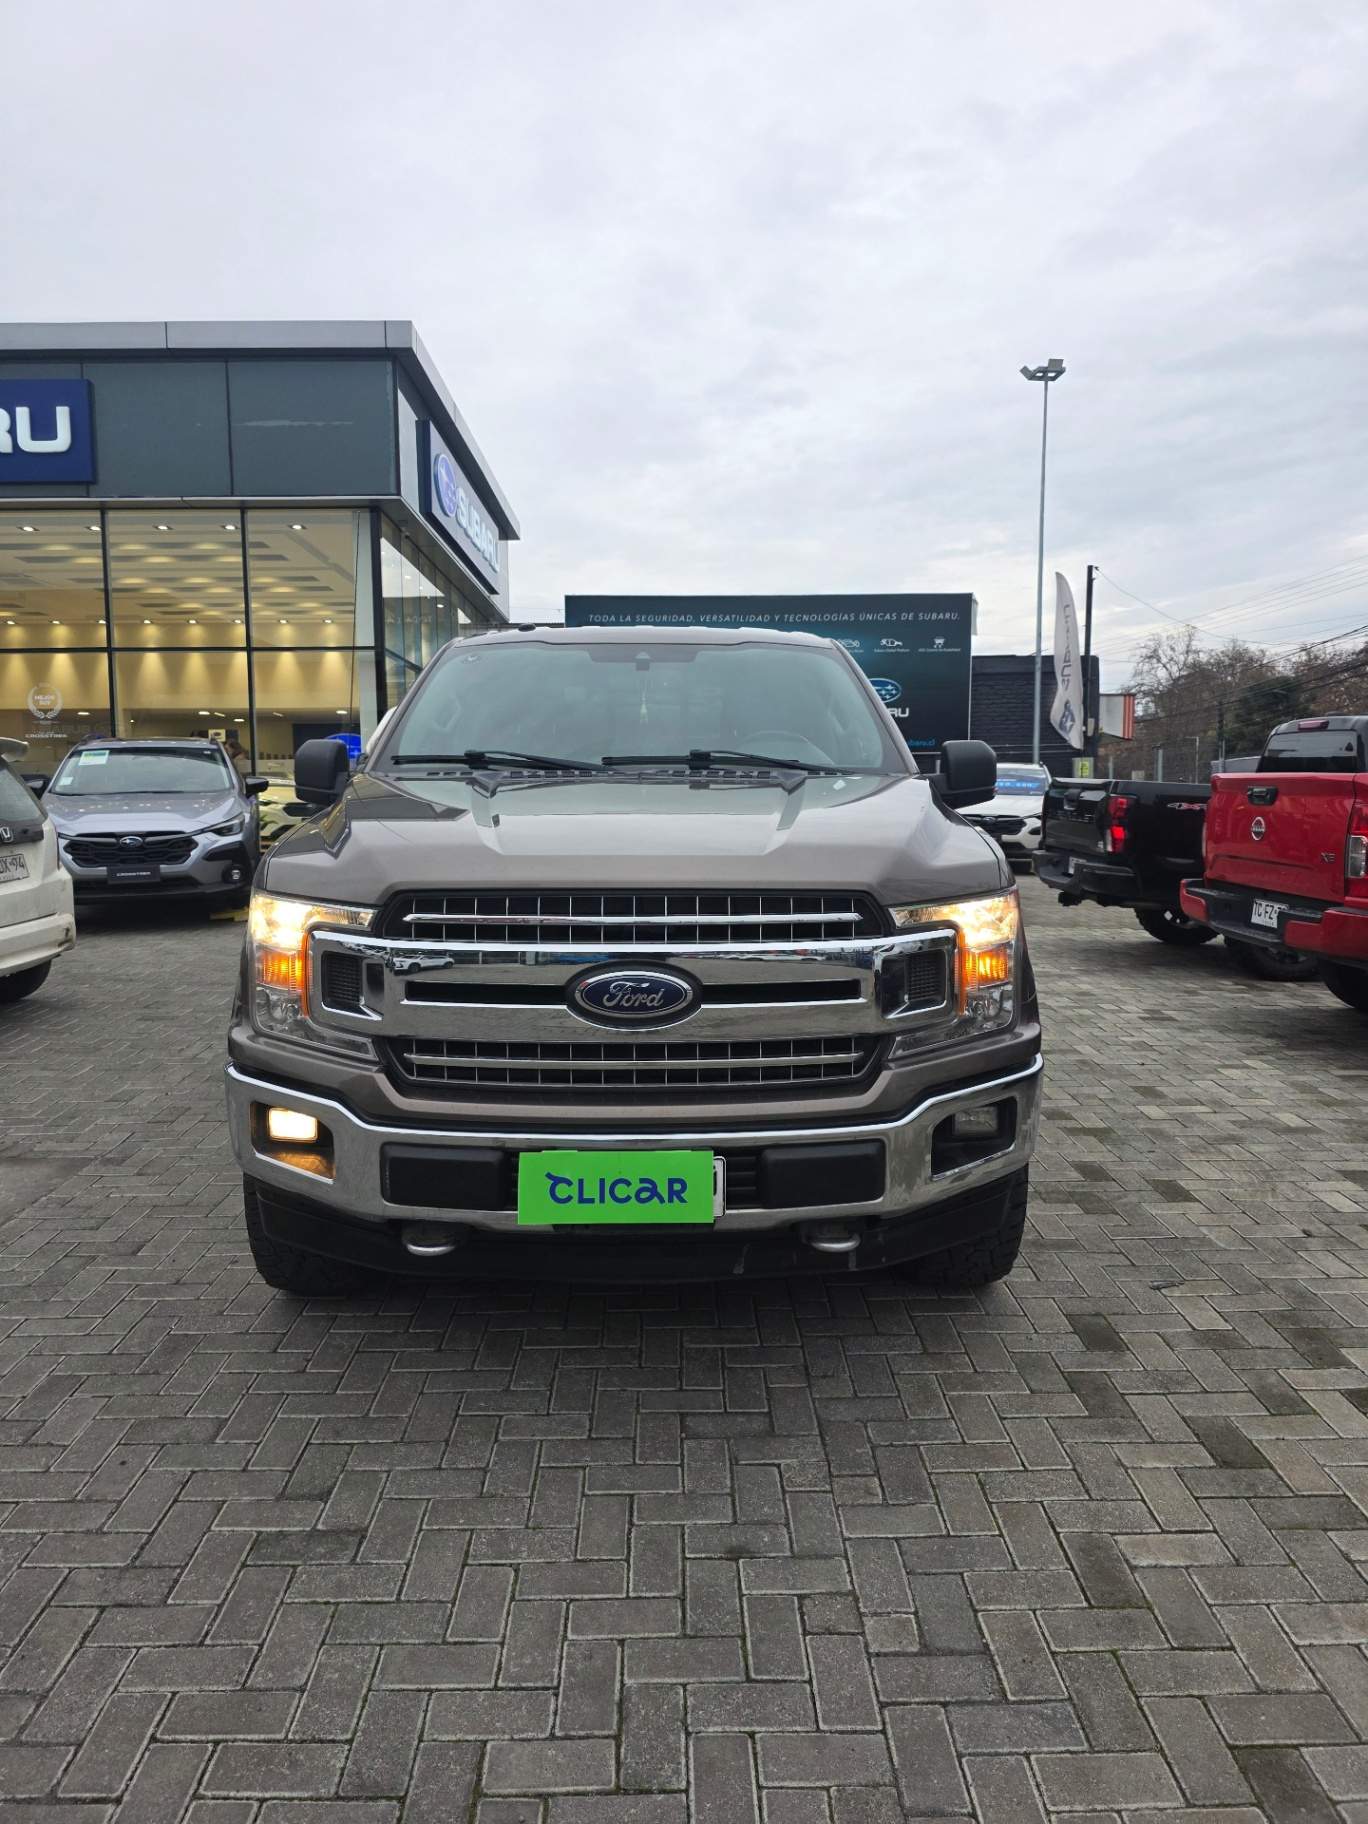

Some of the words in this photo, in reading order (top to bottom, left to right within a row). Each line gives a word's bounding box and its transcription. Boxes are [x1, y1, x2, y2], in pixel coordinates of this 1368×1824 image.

[0, 406, 71, 453] U
[456, 487, 499, 573] SUBARU
[589, 614, 616, 623] TODA
[619, 614, 631, 623] LA
[700, 613, 771, 622] VERSATILIDAD
[774, 613, 780, 622] Y
[784, 612, 855, 622] TECNOLOGÍAS
[859, 611, 897, 621] ÚNICAS
[900, 612, 914, 621] DE
[603, 981, 664, 1007] Ford
